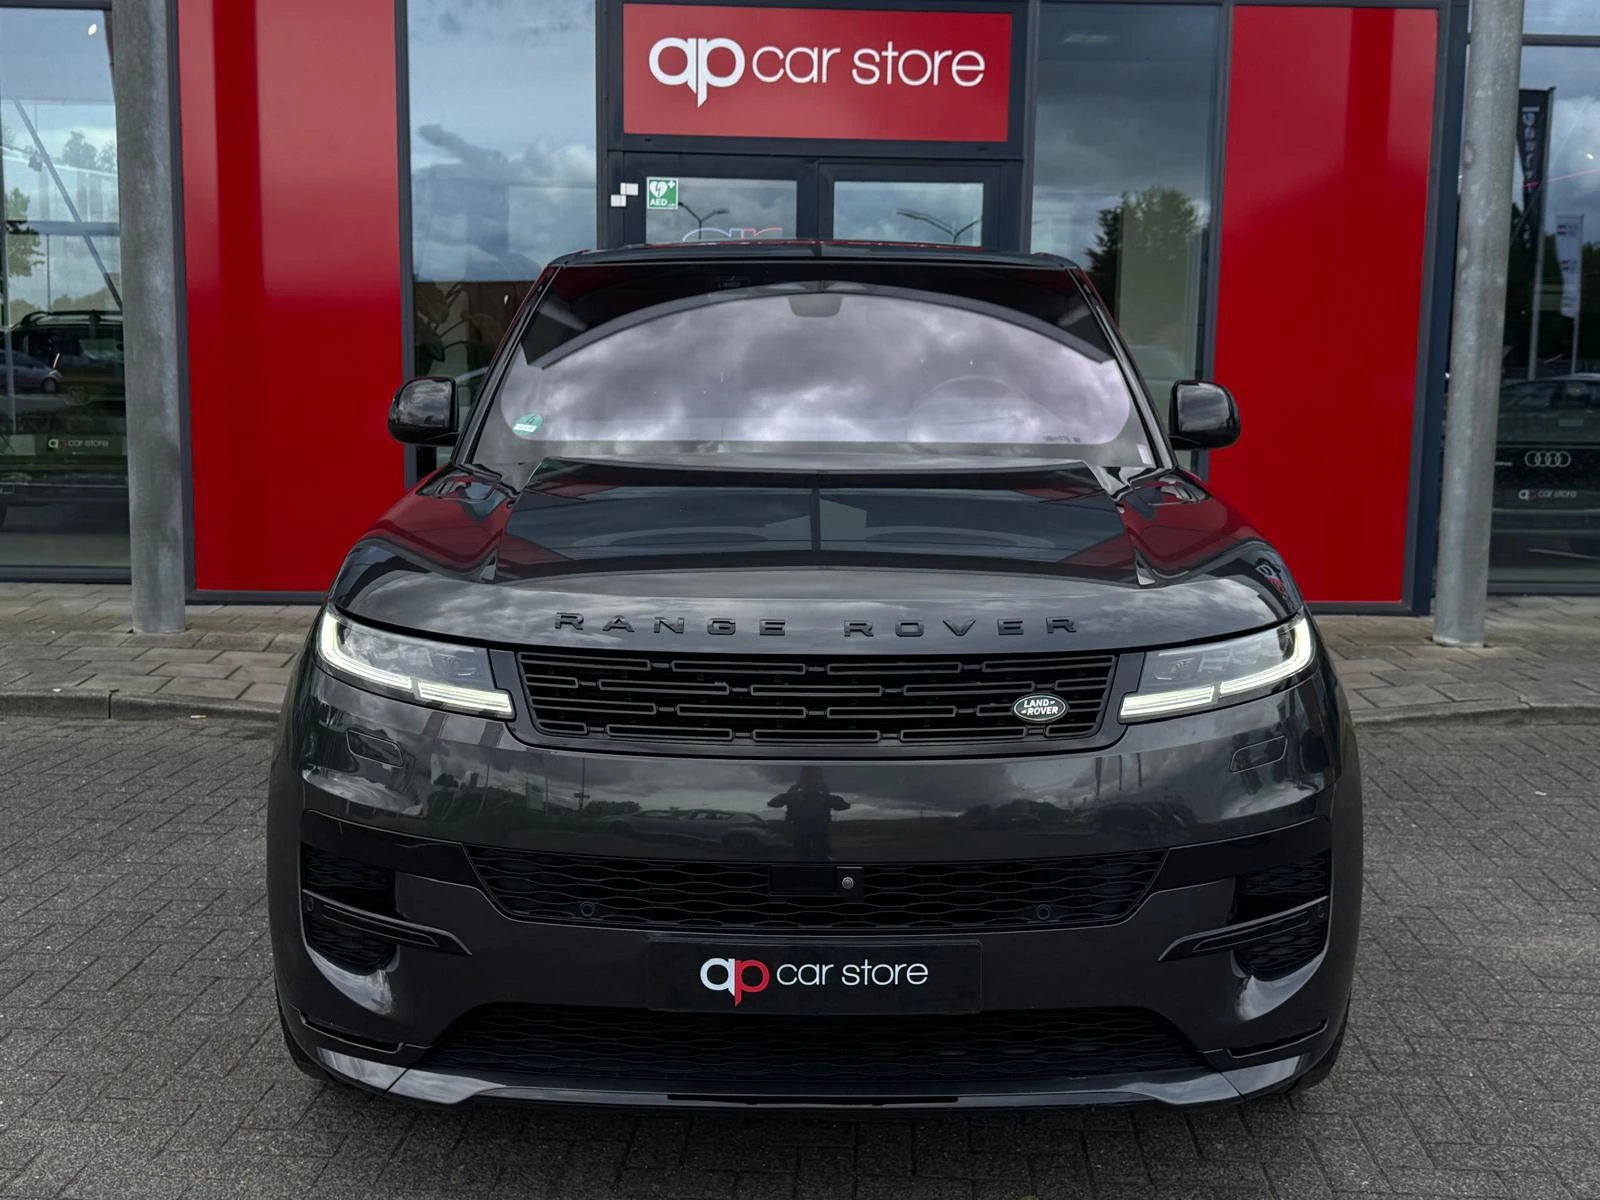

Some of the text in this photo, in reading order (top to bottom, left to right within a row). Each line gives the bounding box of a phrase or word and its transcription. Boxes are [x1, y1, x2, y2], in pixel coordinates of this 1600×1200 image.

[648, 36, 986, 108] ap car store
[650, 198, 667, 206] AED
[554, 612, 1077, 637] RANGE ROVER
[699, 957, 929, 1007] ap car store
